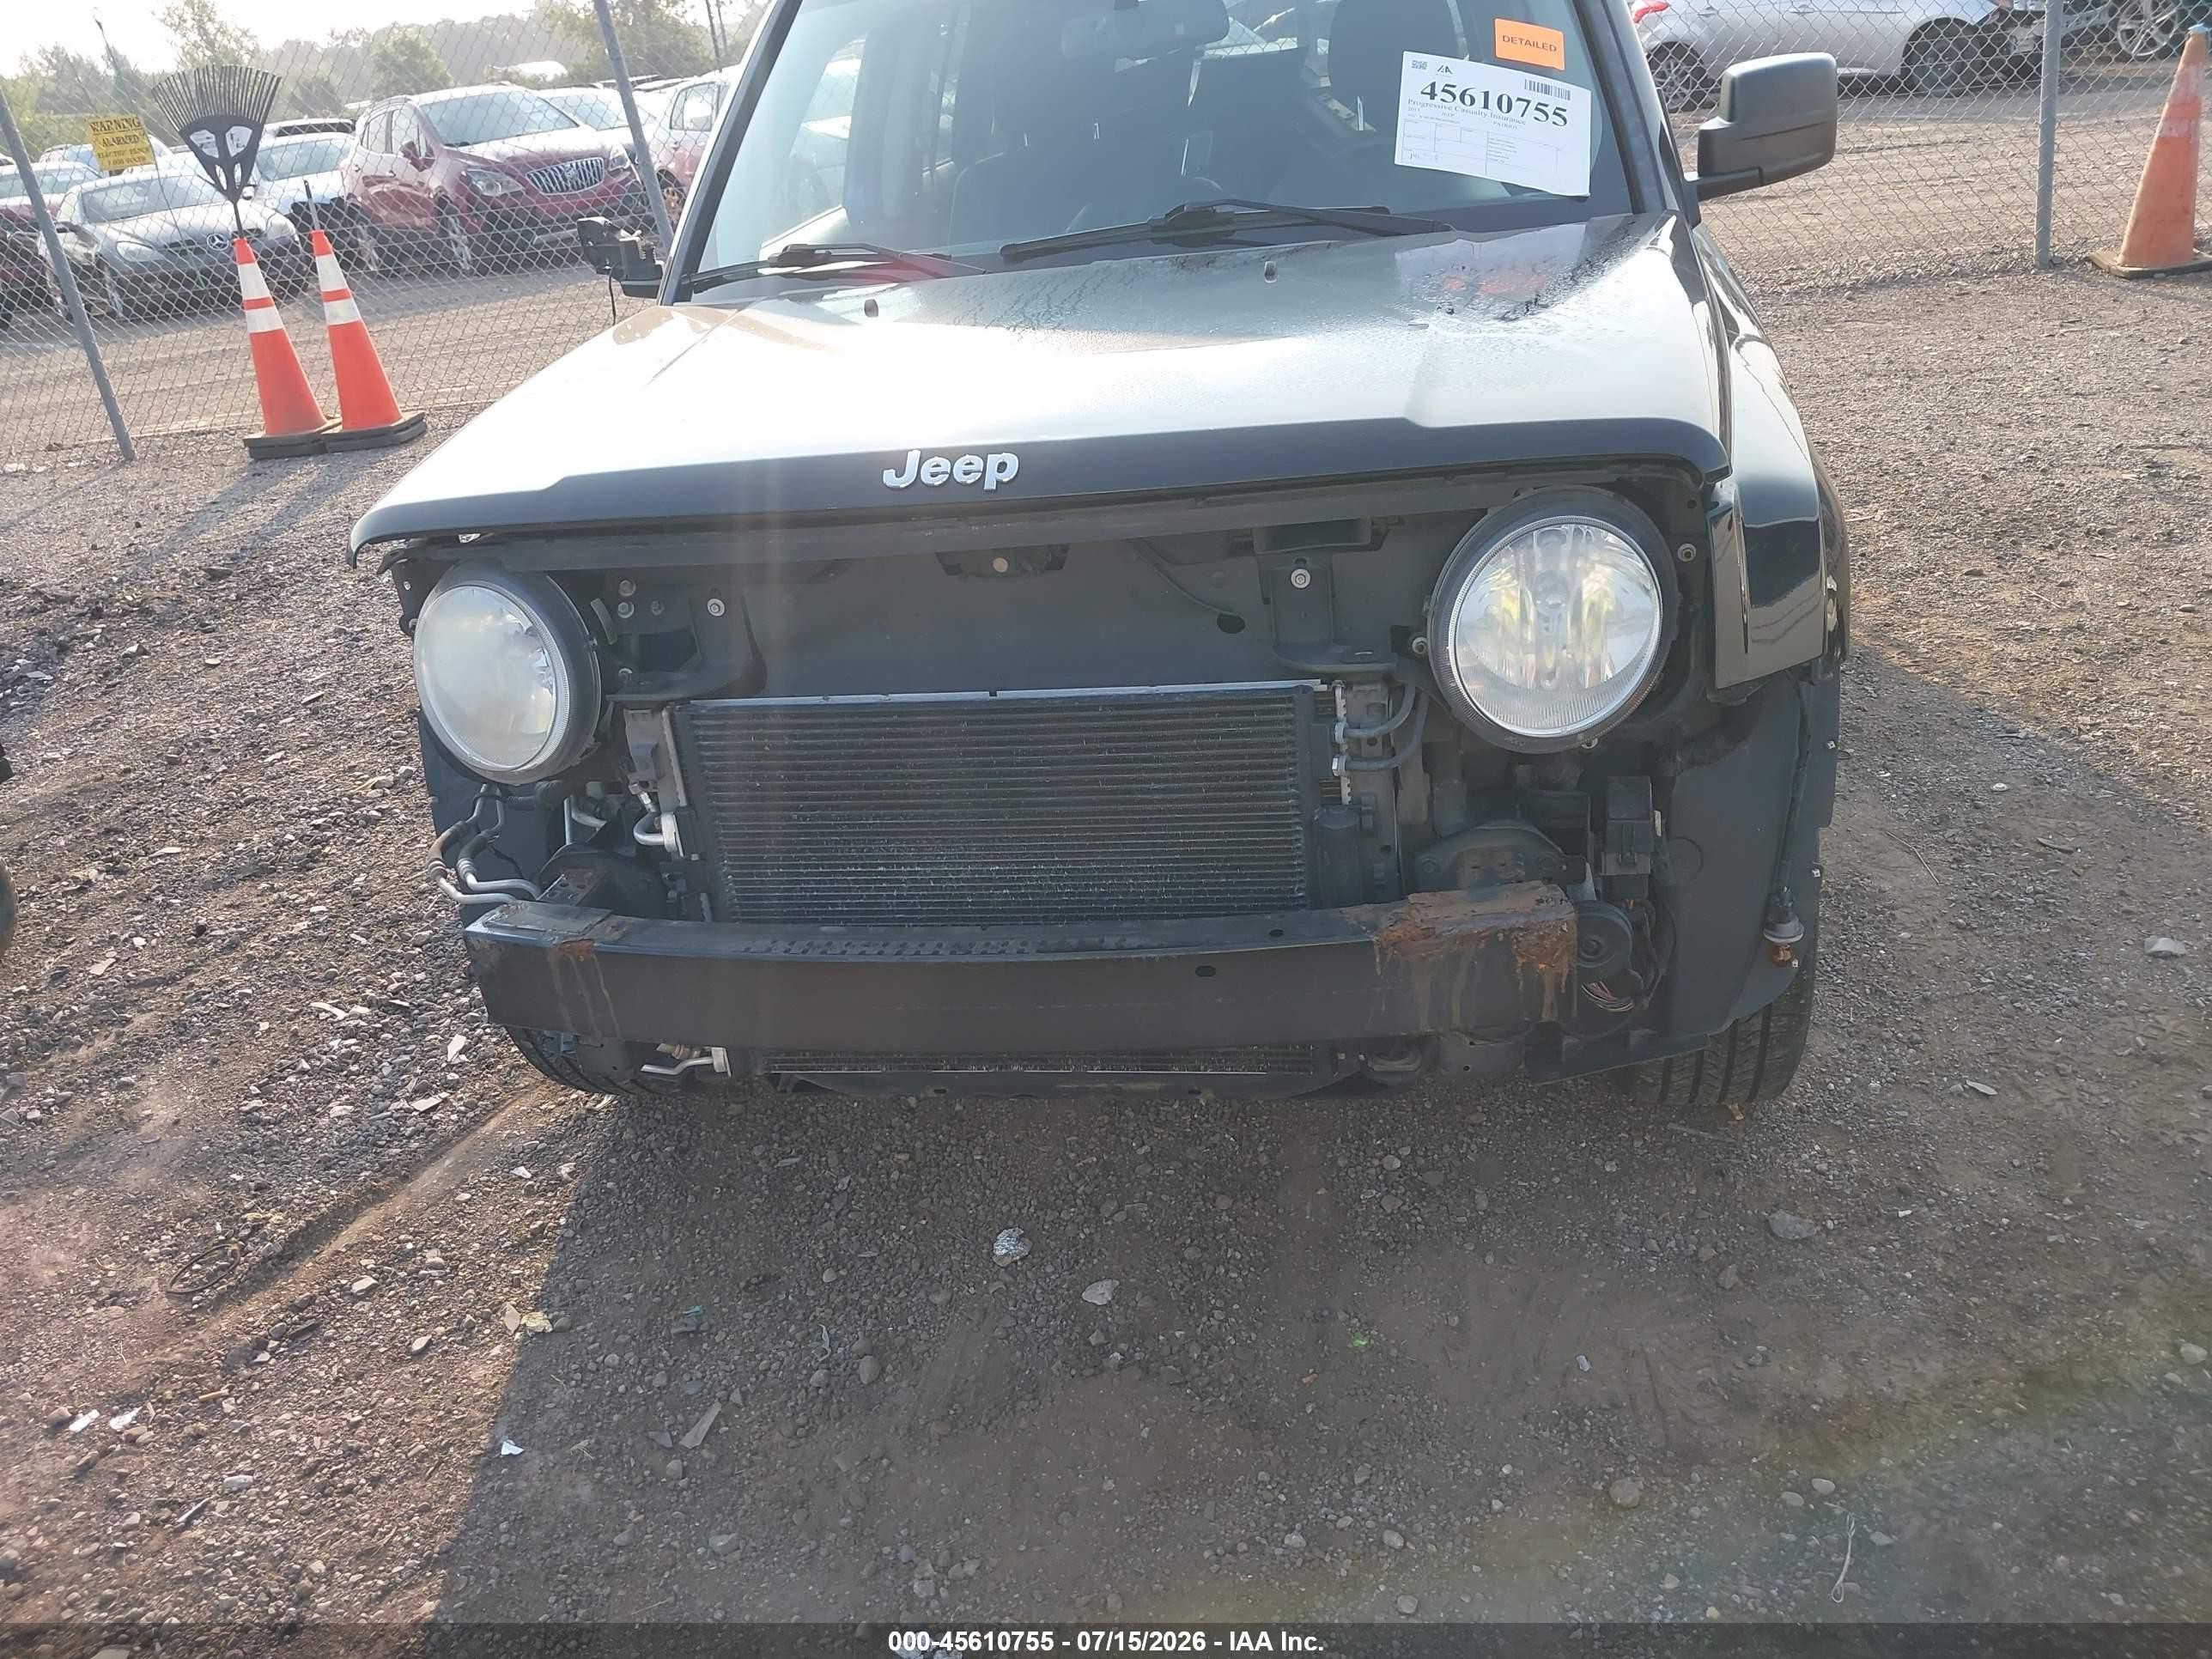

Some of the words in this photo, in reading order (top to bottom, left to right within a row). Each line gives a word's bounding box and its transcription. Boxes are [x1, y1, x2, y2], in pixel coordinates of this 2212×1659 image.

[1502, 34, 1557, 52] DETAILED
[1407, 99, 1453, 111] Progressive
[1455, 106, 1488, 118] Casualty
[1490, 112, 1526, 125] Insurance
[1420, 81, 1568, 127] 45610755
[89, 117, 141, 132] WARNING
[883, 449, 1019, 491] Jeep
